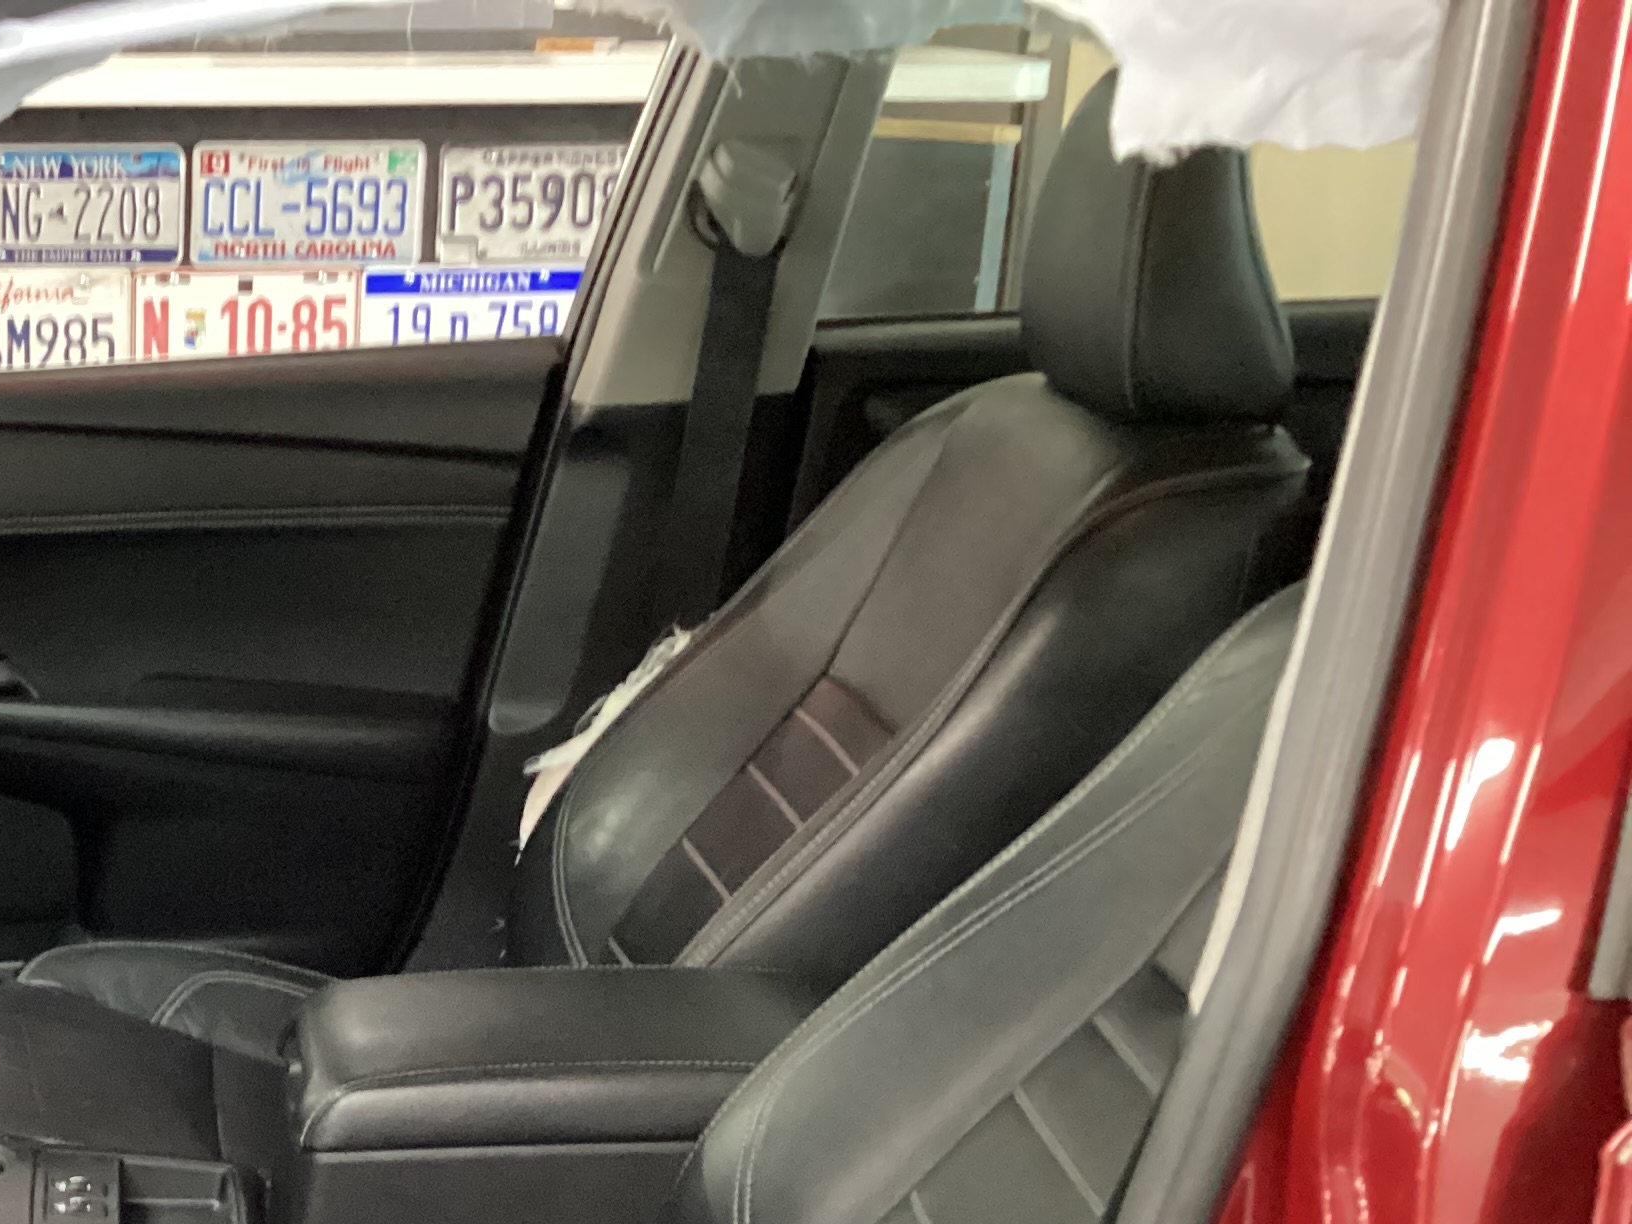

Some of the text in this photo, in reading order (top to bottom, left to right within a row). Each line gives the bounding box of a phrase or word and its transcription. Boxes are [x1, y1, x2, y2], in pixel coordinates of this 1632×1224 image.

[13, 155, 126, 179] NEW YORK
[324, 154, 371, 173] Flight
[214, 239, 397, 260] NORTH CAROLINA
[419, 273, 531, 293] MICHIGAN
[142, 296, 170, 361] N
